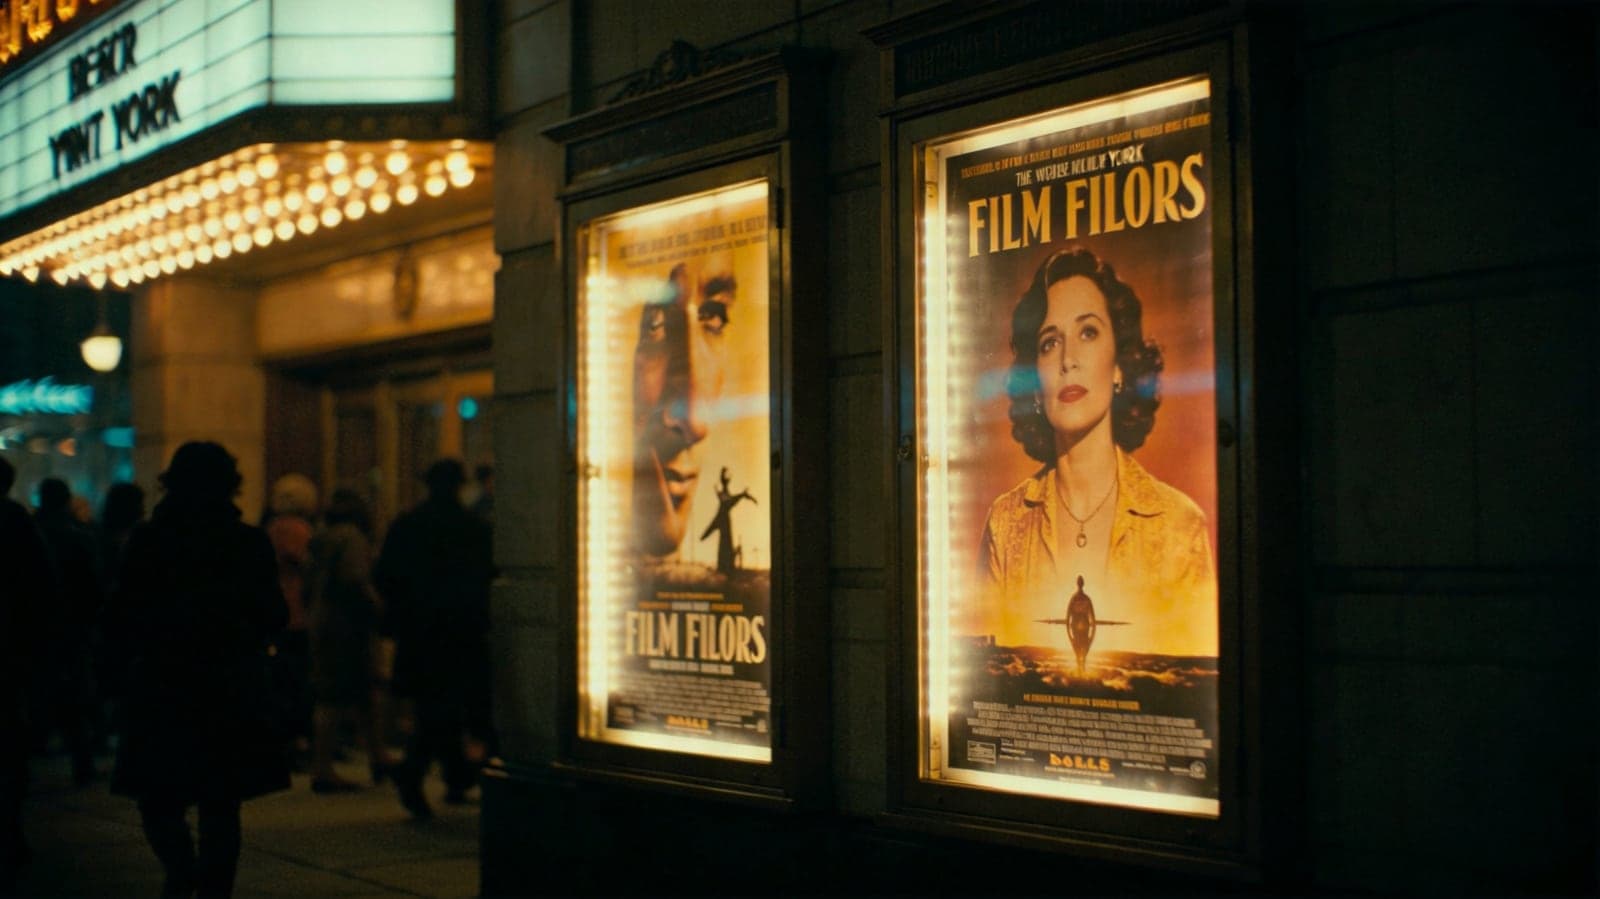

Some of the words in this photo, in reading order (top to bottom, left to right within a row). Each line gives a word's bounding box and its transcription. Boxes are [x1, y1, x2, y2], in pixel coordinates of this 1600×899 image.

[111, 70, 181, 150] YORK
[968, 186, 1051, 258] FILM
[1066, 152, 1206, 240] FILORS
[625, 611, 679, 658] FILM
[685, 613, 767, 664] FILORS
